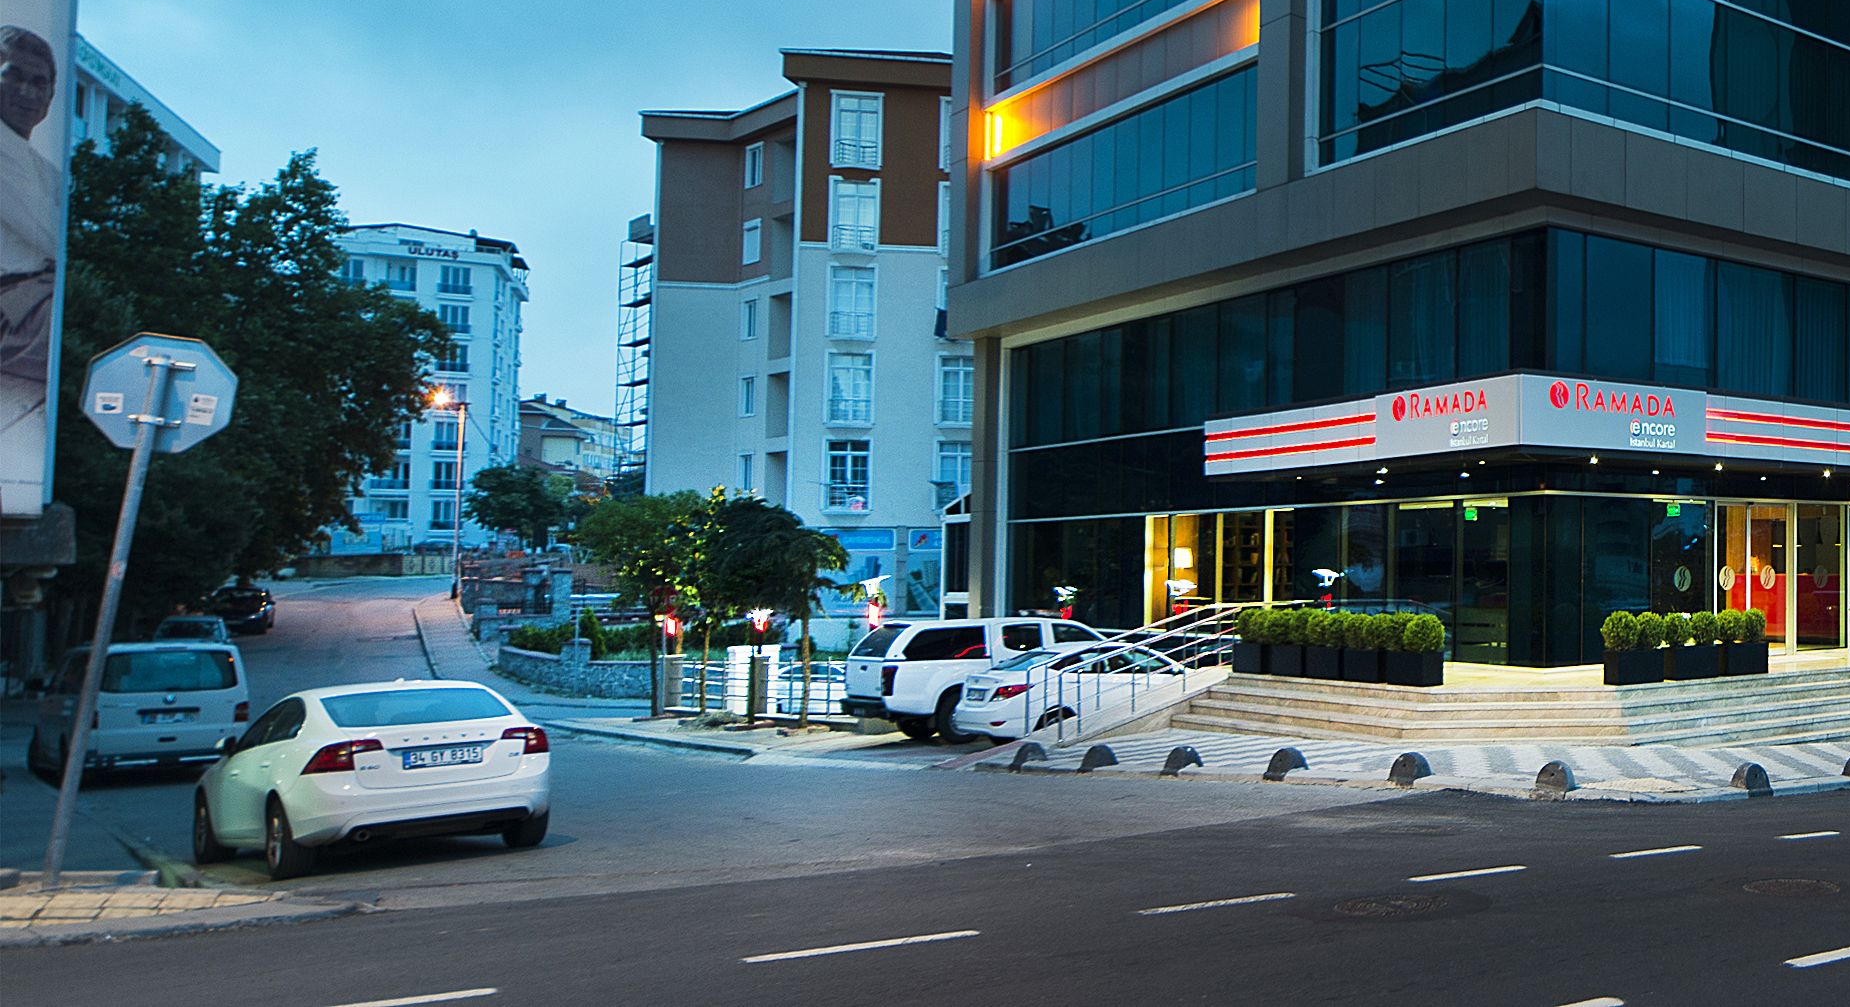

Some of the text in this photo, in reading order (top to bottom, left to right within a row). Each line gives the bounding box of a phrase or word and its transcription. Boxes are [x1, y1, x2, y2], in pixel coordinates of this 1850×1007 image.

[408, 245, 459, 260] ULUTAŞ
[1410, 388, 1488, 419] RAMADA
[1576, 383, 1676, 417] RAMADA
[1450, 419, 1489, 437] encore
[1630, 419, 1676, 437] encore
[411, 747, 480, 764] 34 GY 8315
